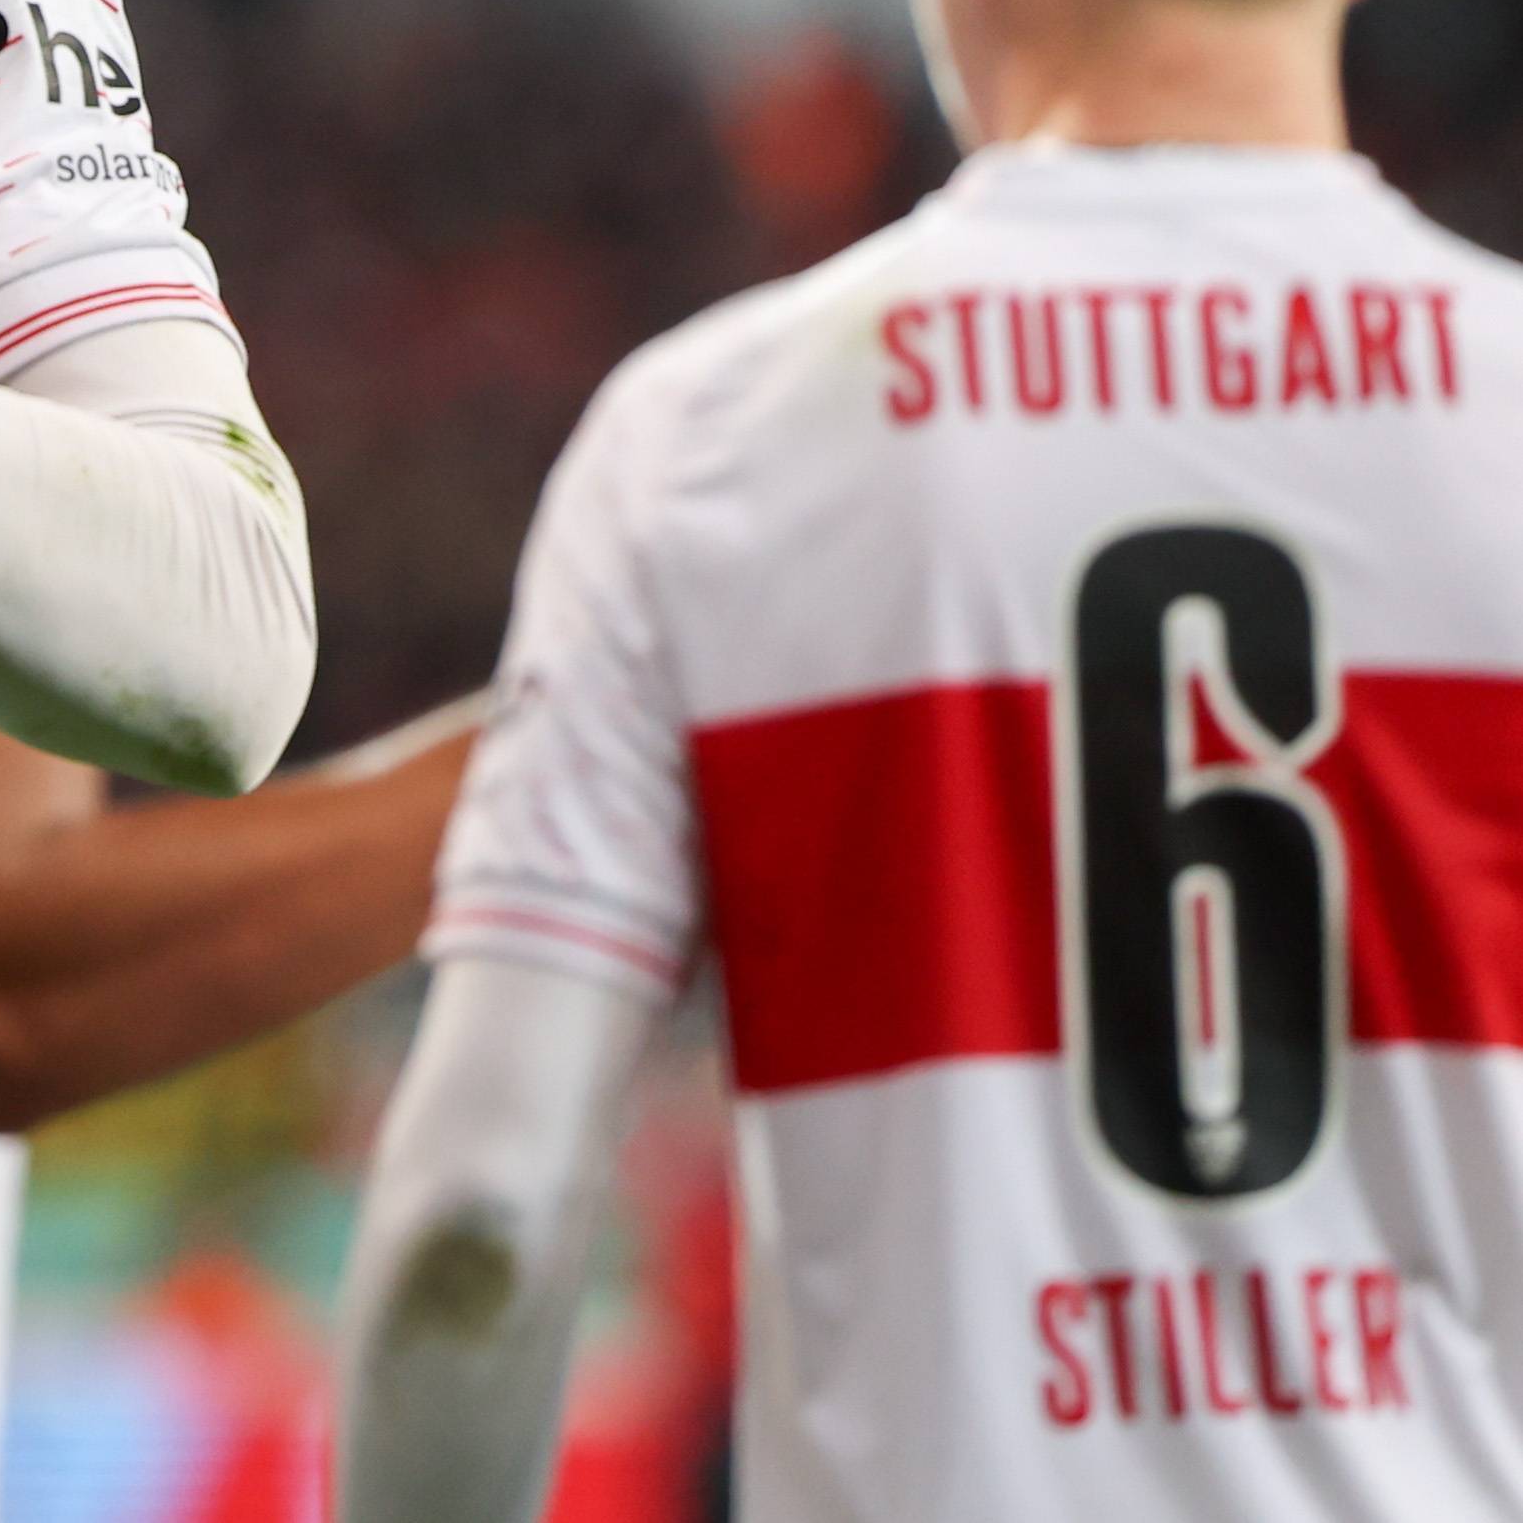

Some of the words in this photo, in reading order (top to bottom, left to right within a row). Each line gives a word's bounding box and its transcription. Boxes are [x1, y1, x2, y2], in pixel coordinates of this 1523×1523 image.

[883, 284, 1465, 428] STUTTGART
[1073, 524, 1333, 1198] 6
[1036, 1269, 1411, 1431] STILLER
